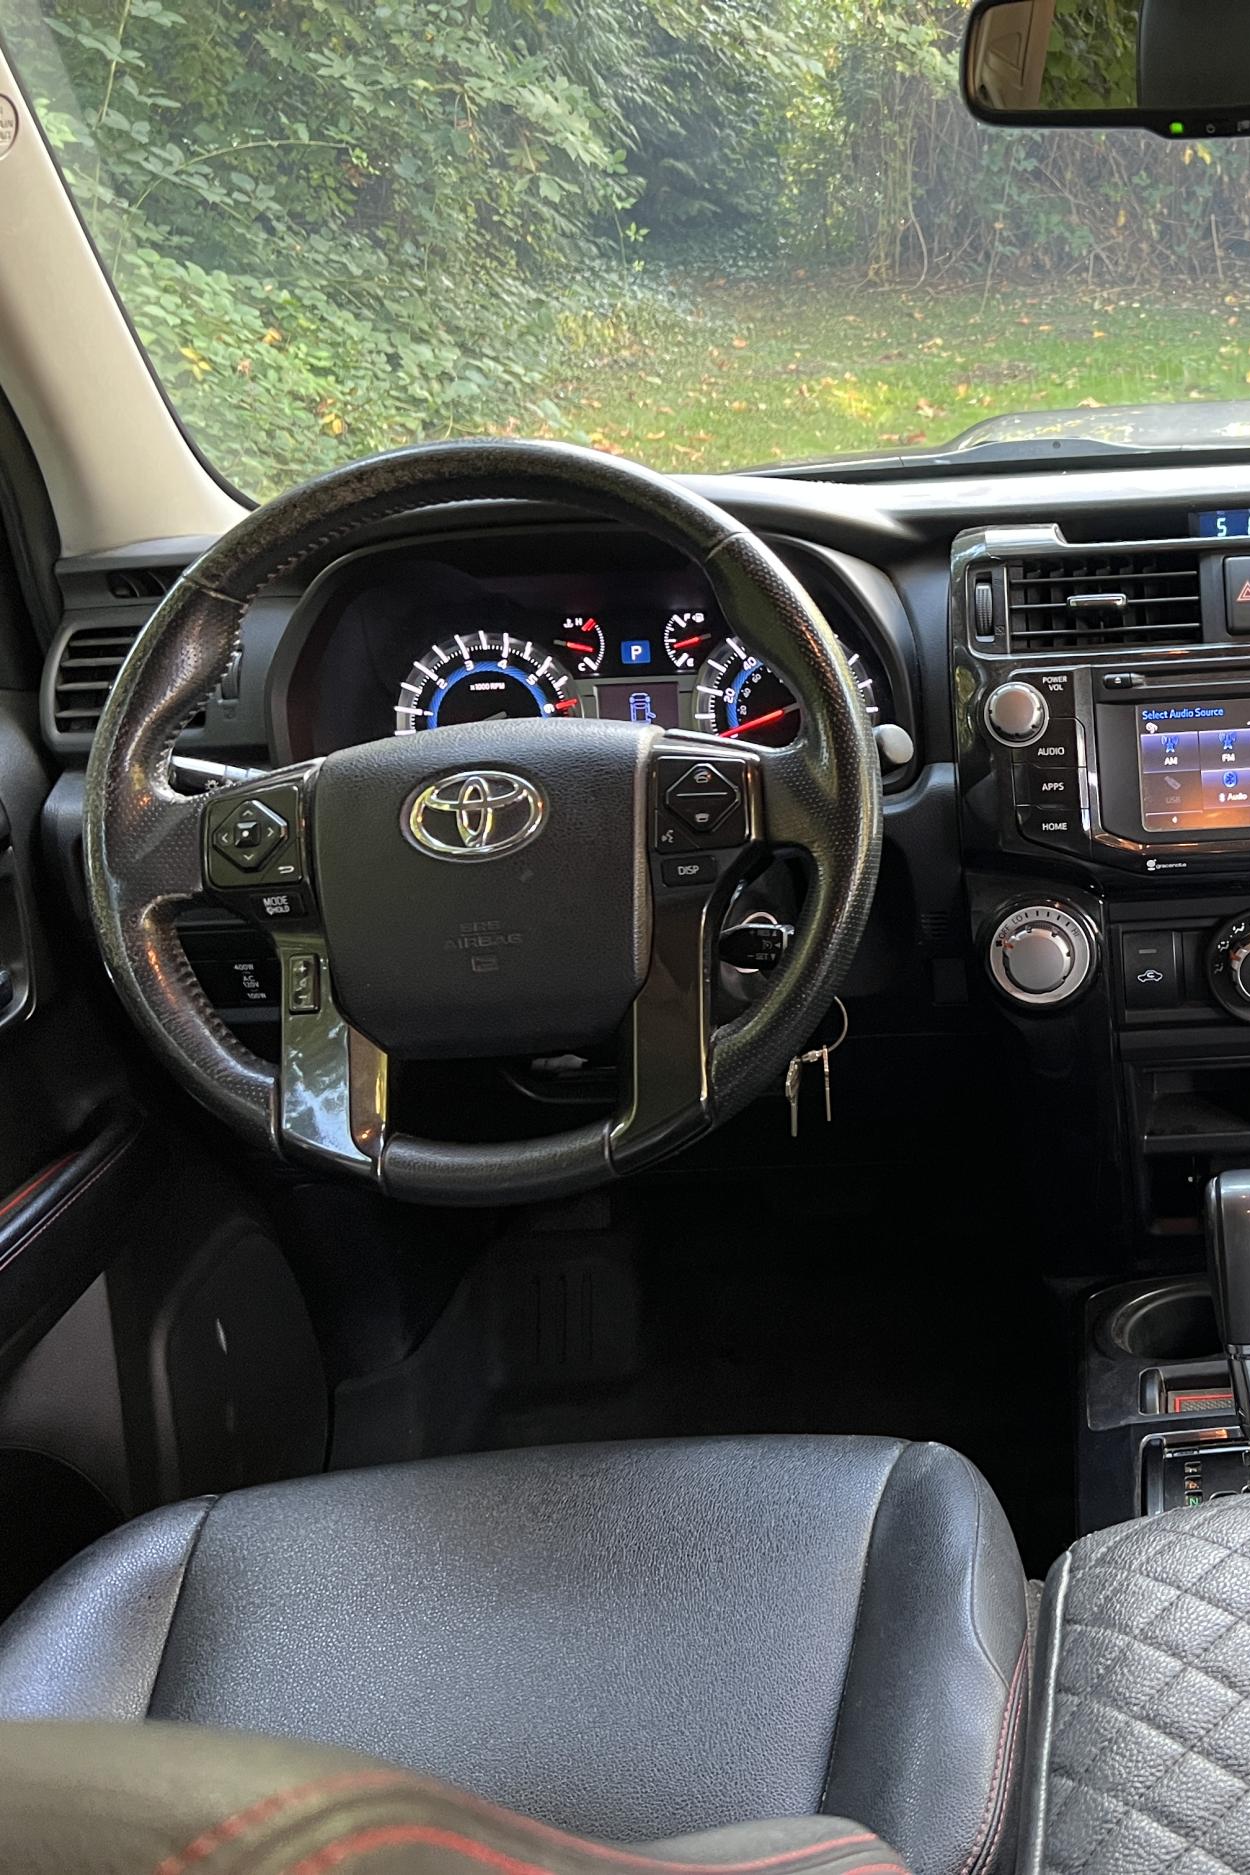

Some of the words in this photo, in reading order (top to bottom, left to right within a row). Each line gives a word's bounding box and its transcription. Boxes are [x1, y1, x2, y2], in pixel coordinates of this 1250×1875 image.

[574, 617, 583, 626] H
[683, 612, 691, 622] F
[630, 645, 643, 661] P
[464, 659, 475, 672] 3
[497, 659, 508, 670] 4
[577, 662, 587, 672] C
[743, 656, 757, 671] 40
[436, 678, 448, 690] 2
[525, 673, 538, 686] 5
[1042, 675, 1068, 684] POWER
[1048, 683, 1064, 691] VOL
[723, 687, 736, 704] 20
[1142, 710, 1168, 720] Select
[1169, 708, 1194, 719] Audio
[1194, 707, 1224, 717] Source
[1037, 746, 1065, 757] AUDIO
[1164, 756, 1179, 766] AM
[1221, 753, 1236, 763] FM
[1041, 782, 1065, 791] APPS
[1227, 792, 1248, 801] Audio
[1042, 822, 1068, 831] HOME
[677, 864, 700, 876] DISP
[263, 895, 289, 907] MODE
[1011, 914, 1023, 925] LO
[998, 923, 1010, 939] OFF
[442, 931, 524, 950] AIRBAG
